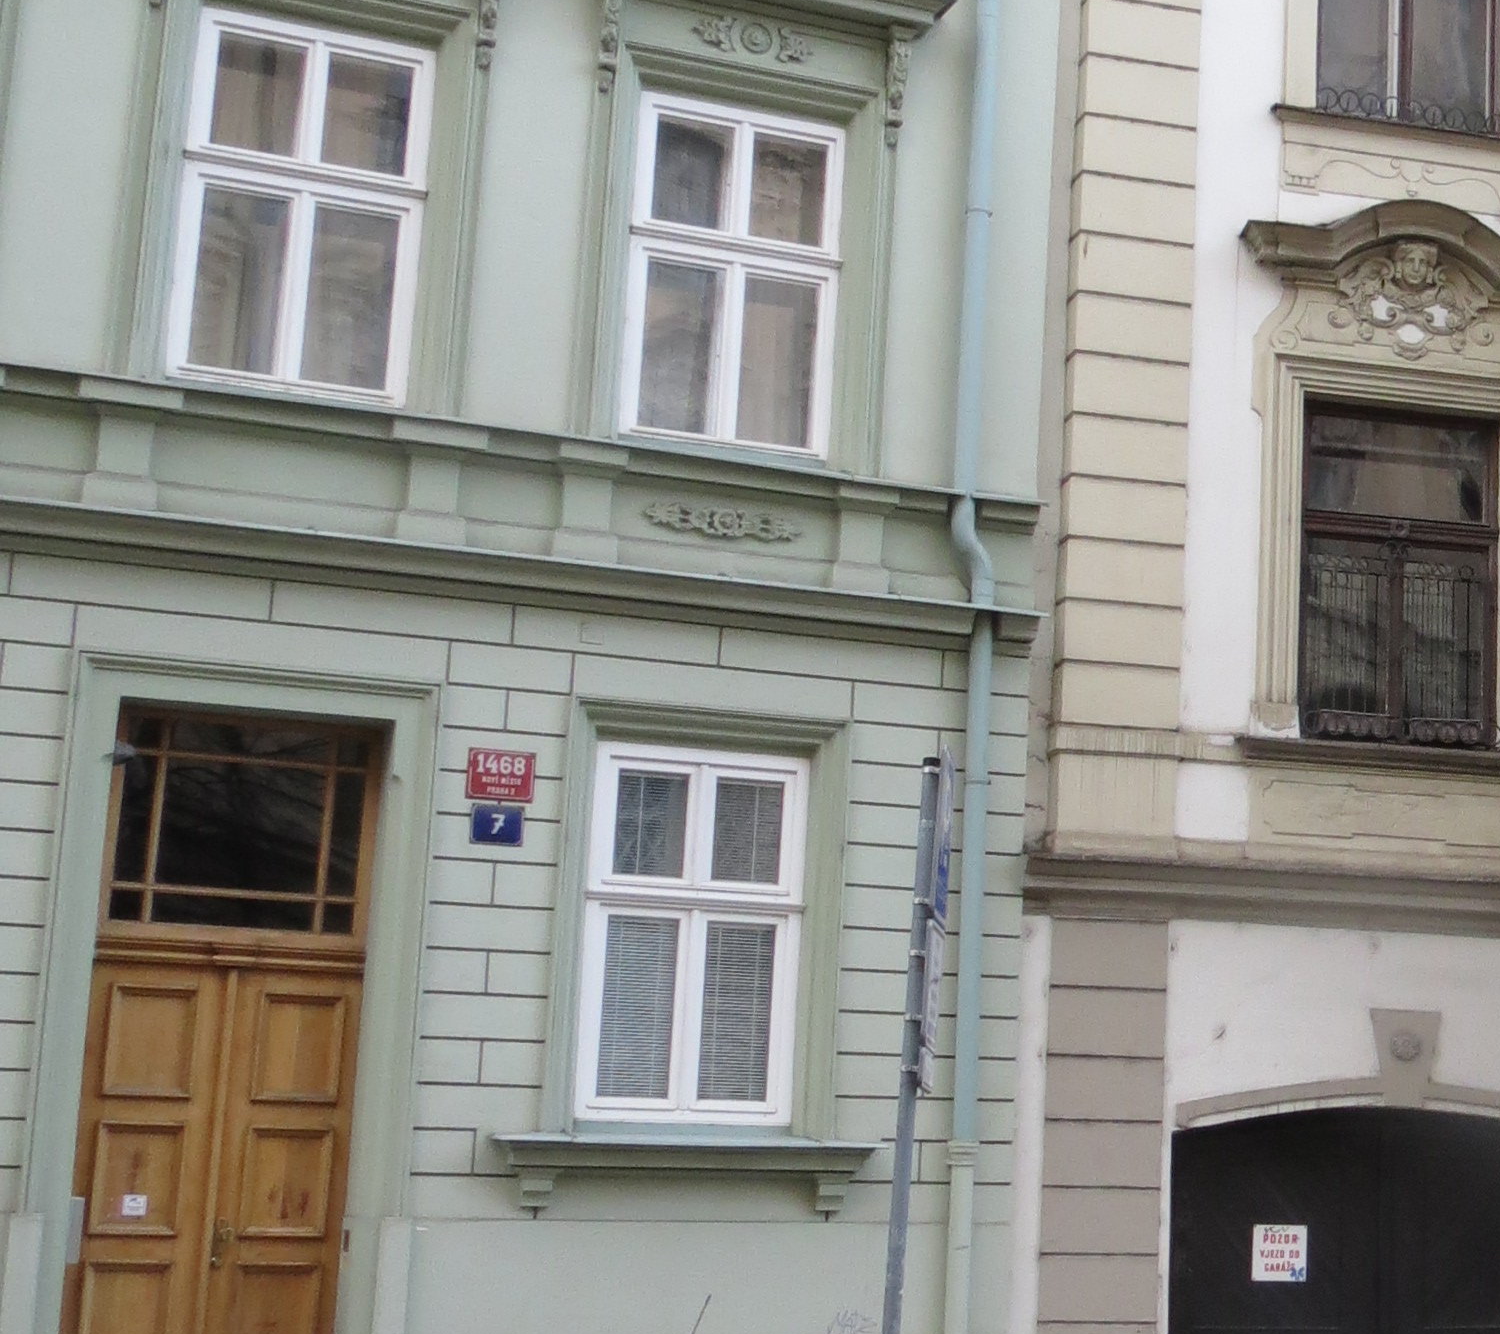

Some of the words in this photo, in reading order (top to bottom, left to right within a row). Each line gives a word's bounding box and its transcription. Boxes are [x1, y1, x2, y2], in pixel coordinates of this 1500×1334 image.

[475, 753, 526, 776] 1468
[490, 813, 506, 835] 7
[1263, 1233, 1298, 1244] POZOR
[1289, 1249, 1300, 1259] DO
